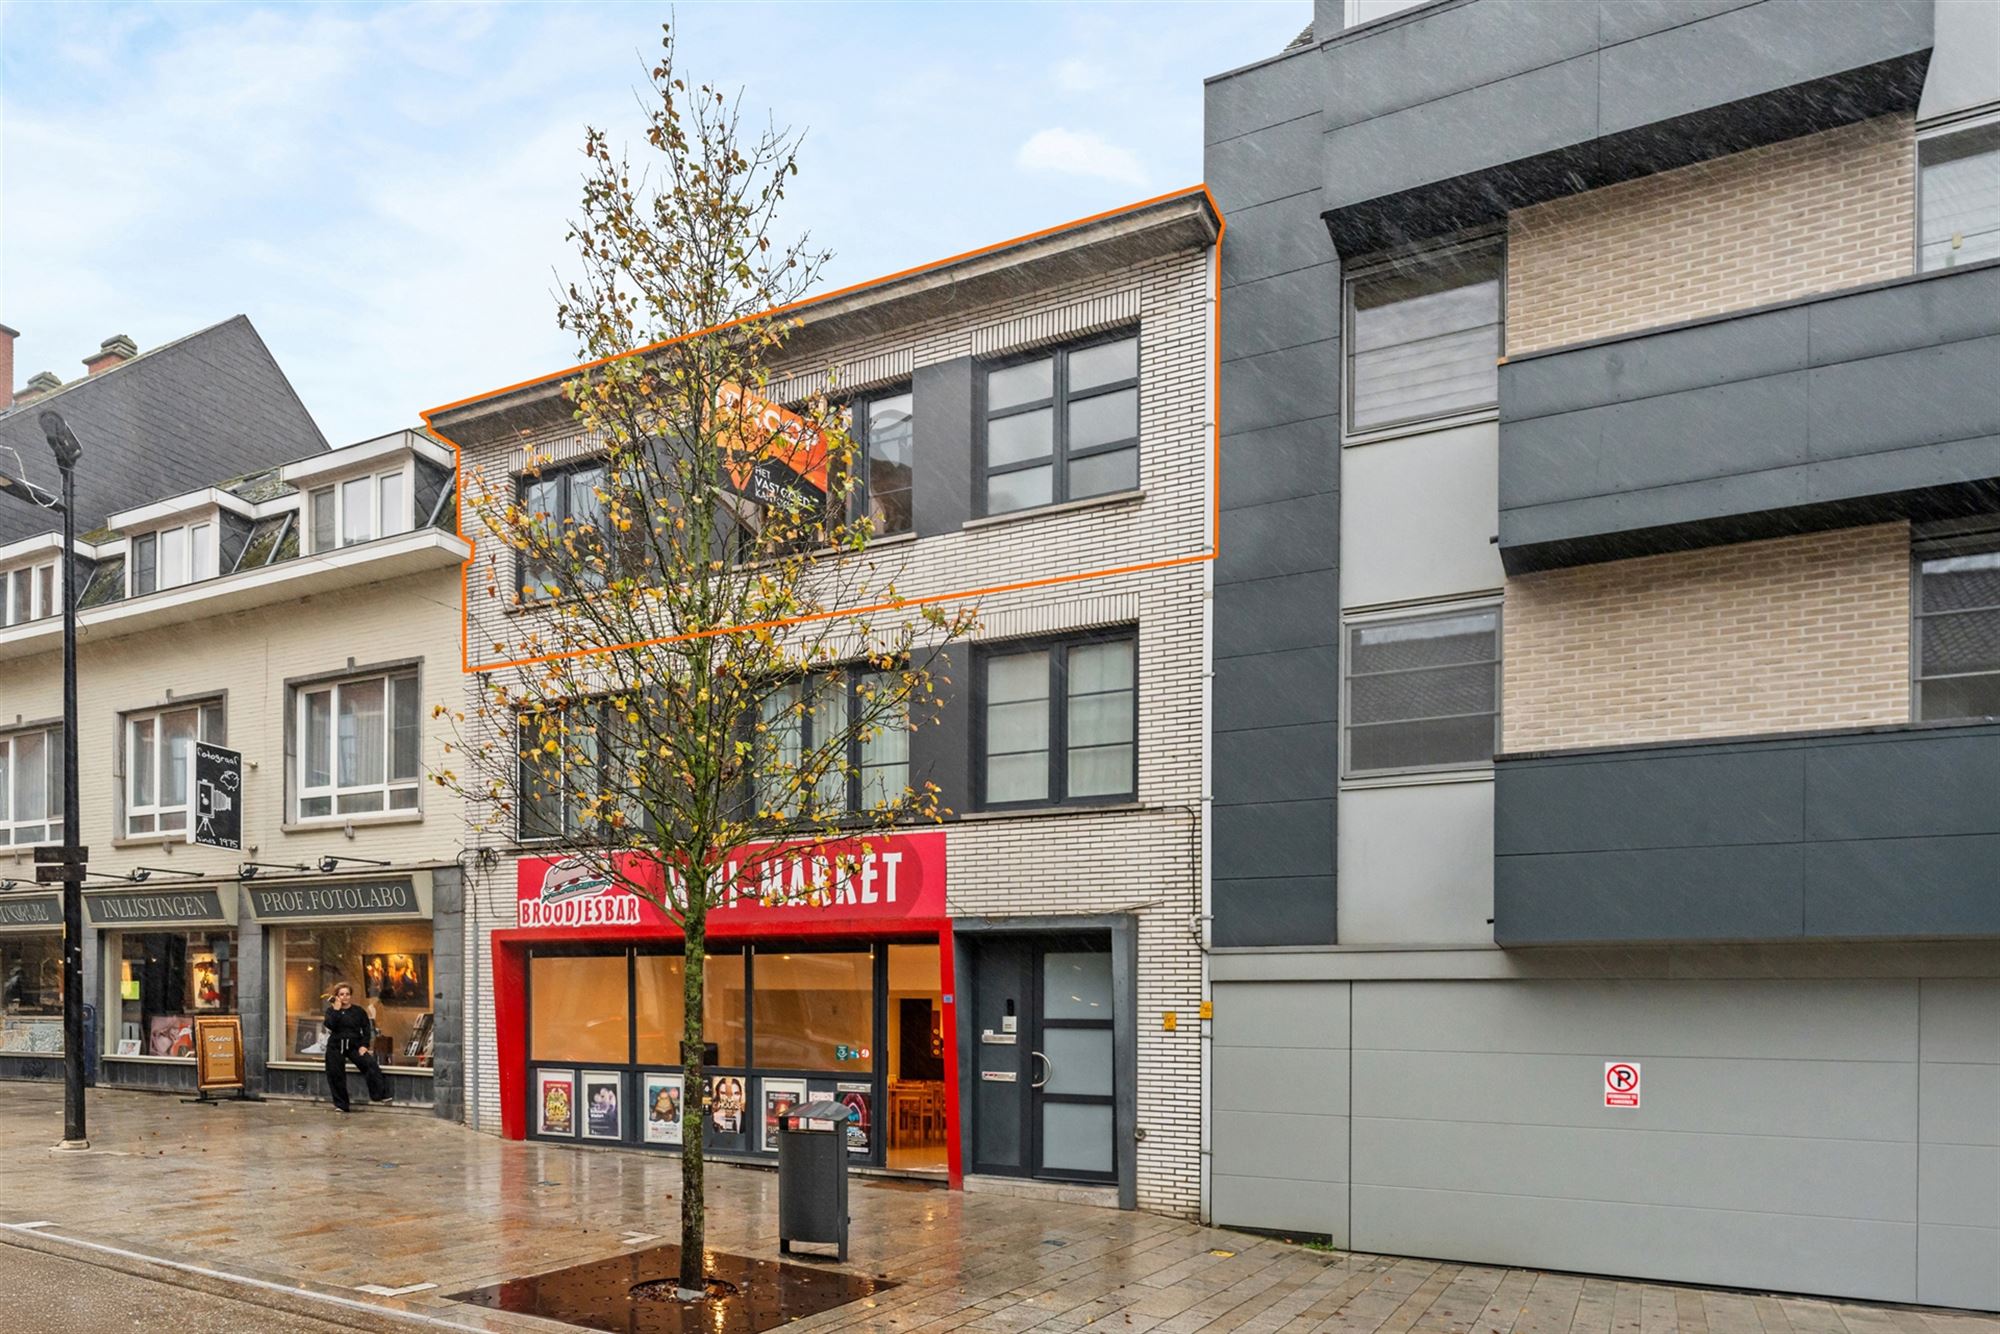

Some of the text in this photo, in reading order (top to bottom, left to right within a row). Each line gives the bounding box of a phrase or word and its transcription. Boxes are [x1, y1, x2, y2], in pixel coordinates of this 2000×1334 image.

[219, 837, 239, 849] 1975
[664, 852, 903, 909] MNI-MARKET
[101, 895, 209, 919] INLIJSTINGEN
[520, 895, 639, 926] BROODJESBAR
